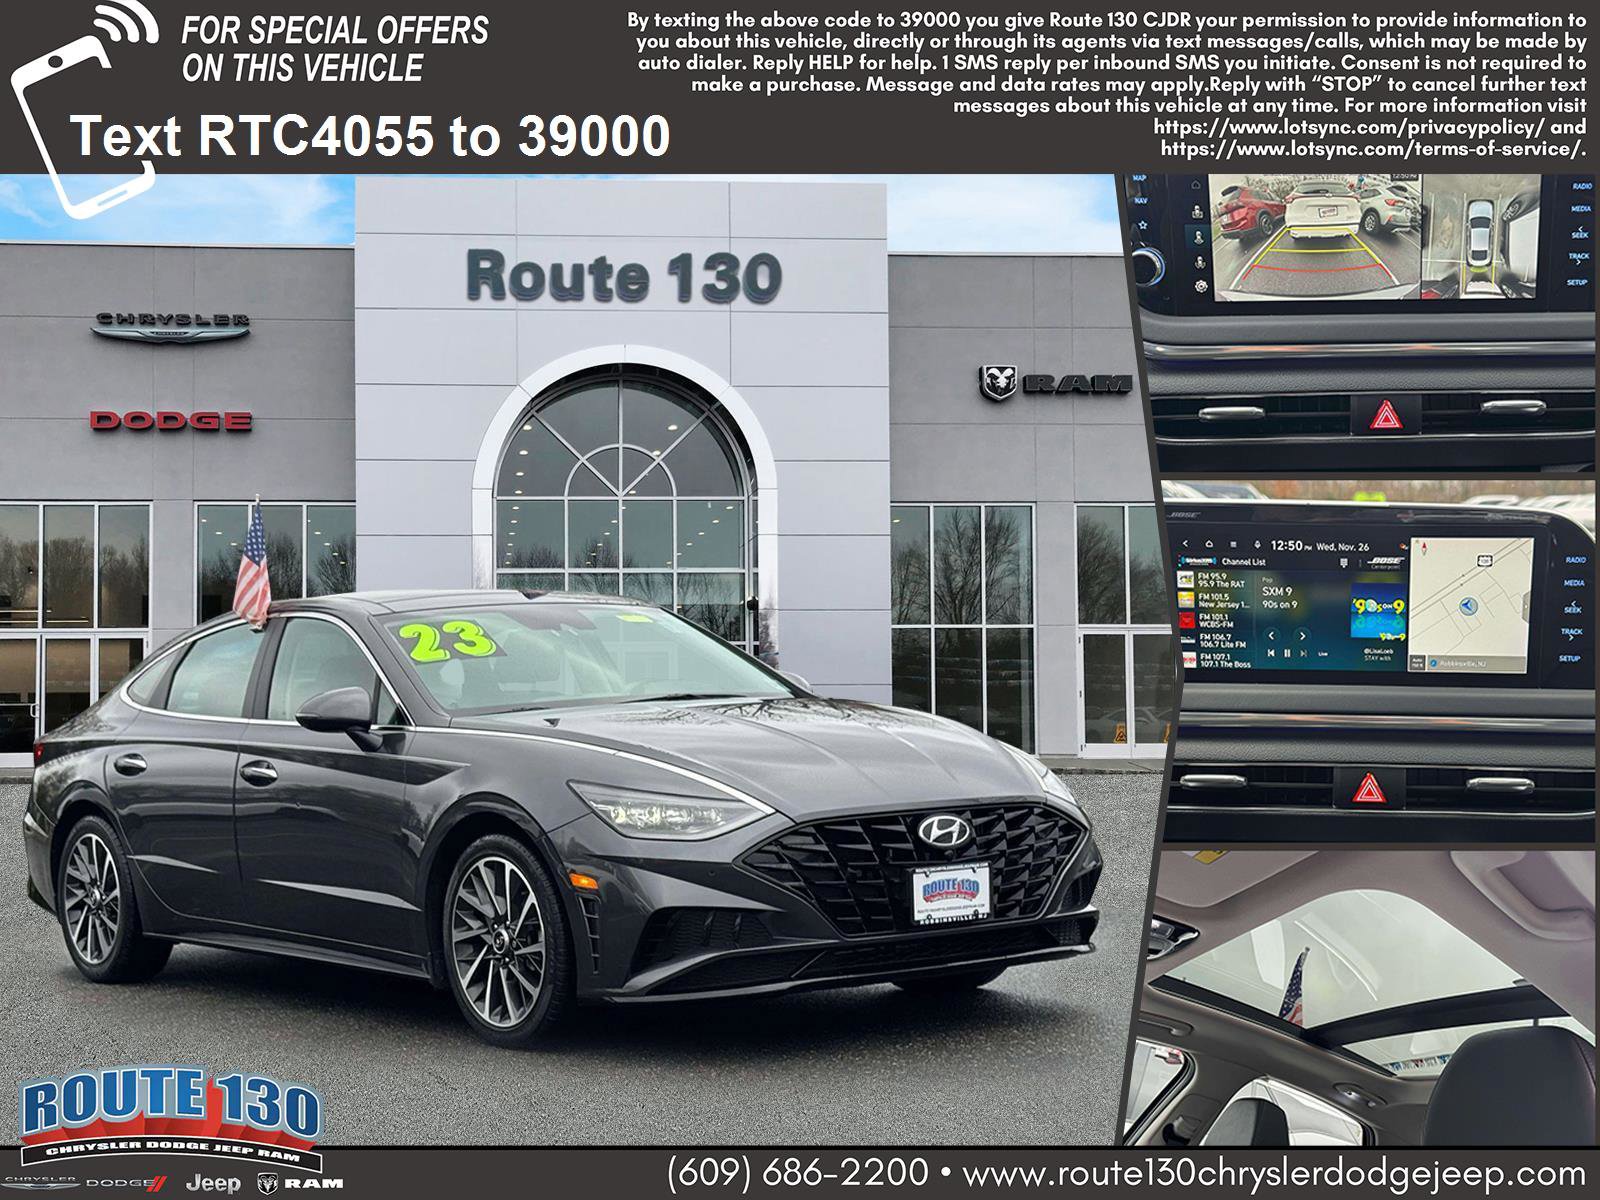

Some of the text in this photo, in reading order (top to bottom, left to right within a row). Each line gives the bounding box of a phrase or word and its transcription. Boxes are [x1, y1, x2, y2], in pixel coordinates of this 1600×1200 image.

[1571, 231, 1589, 239] SEEK
[467, 248, 782, 305] Route 130
[96, 312, 250, 326] CHRYSLER
[1023, 374, 1133, 394] RAM
[90, 410, 252, 431] DODGE
[1271, 540, 1370, 551] 12:50 Nov. 26
[1221, 557, 1266, 566] Channel List
[1566, 556, 1587, 564] RADIO
[1197, 572, 1227, 580] FM 95.9
[1198, 580, 1245, 588] 95.9 The RAT
[1563, 579, 1585, 587] MEDIA
[1262, 586, 1293, 596] SXM 9
[1199, 593, 1210, 601] FM
[1199, 600, 1240, 609] New Jersey
[1262, 600, 1278, 609] 90s
[1564, 606, 1582, 614] SEEK
[399, 620, 497, 663] 23
[1201, 660, 1252, 668] 107.1 The Boss
[923, 878, 957, 897] ROUTE
